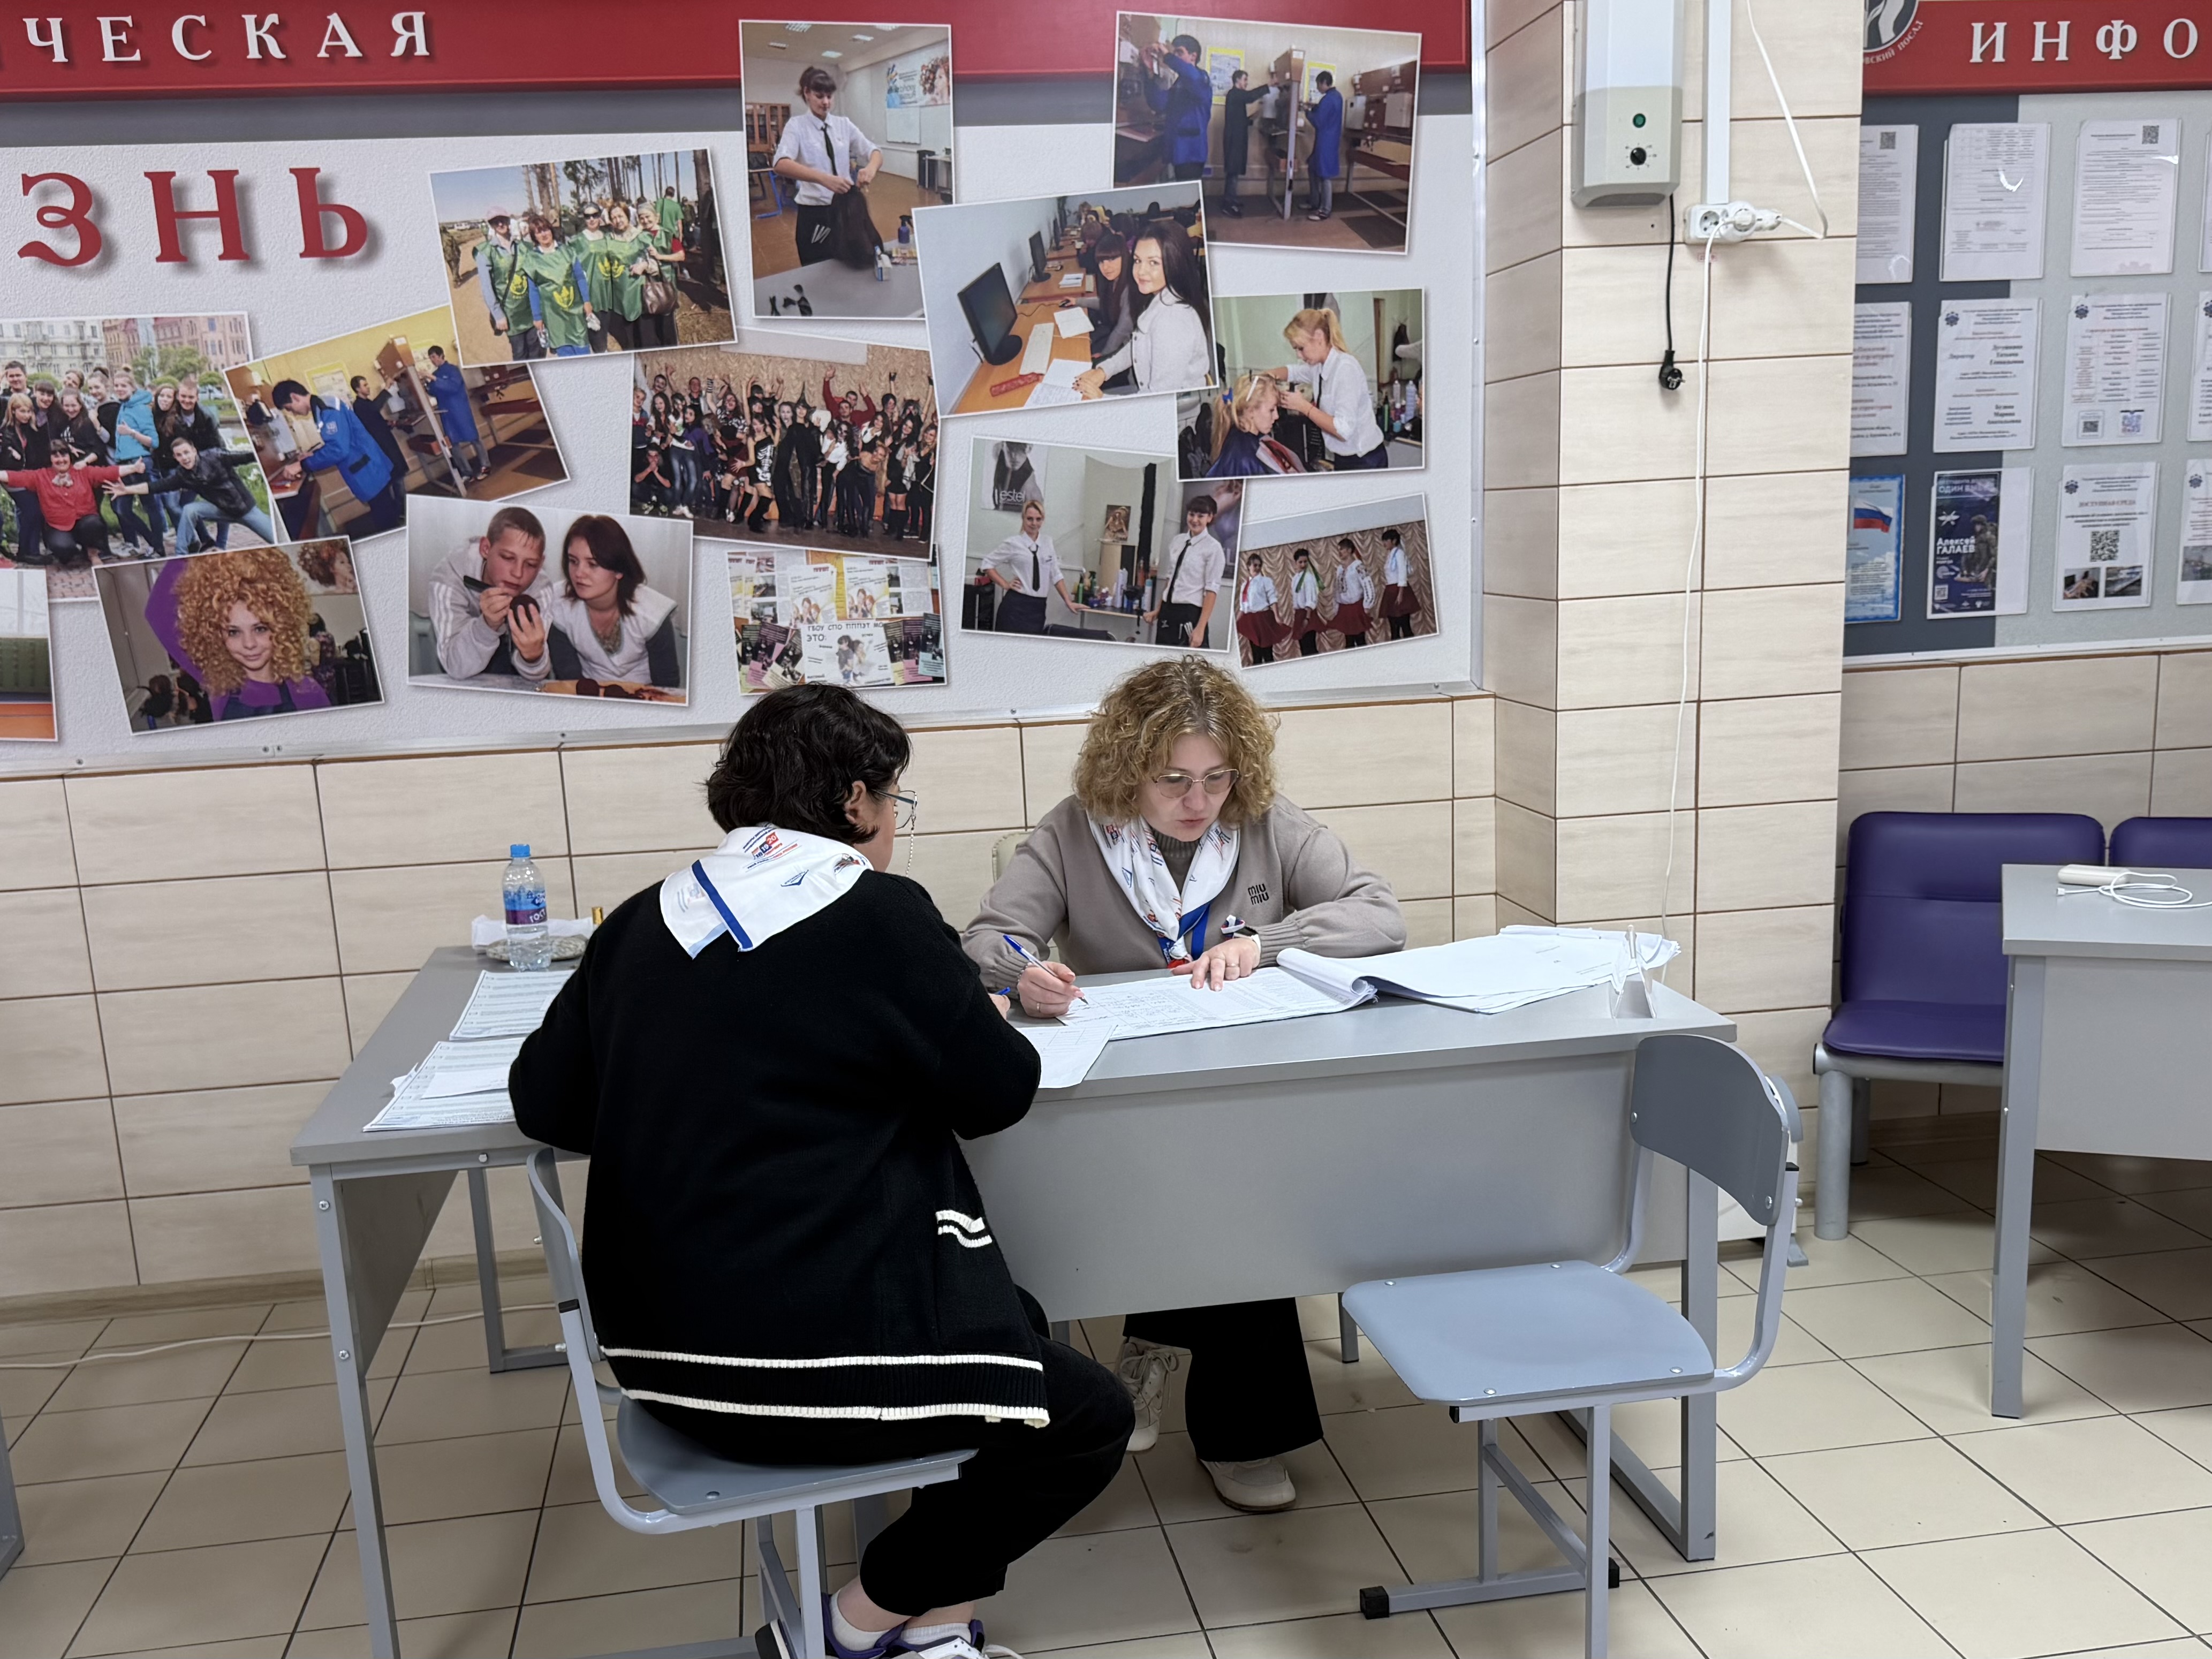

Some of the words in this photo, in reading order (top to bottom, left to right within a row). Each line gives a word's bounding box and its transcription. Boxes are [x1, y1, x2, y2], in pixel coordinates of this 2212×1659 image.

[23, 12, 430, 63] ЧЕСКАЯ
[1969, 18, 2199, 63] ИНФО
[18, 167, 368, 267] ЗНЬ
[1936, 545, 1975, 555] ГАЛАЕВ
[1937, 536, 1975, 546] Алексей
[767, 835, 777, 844] 20
